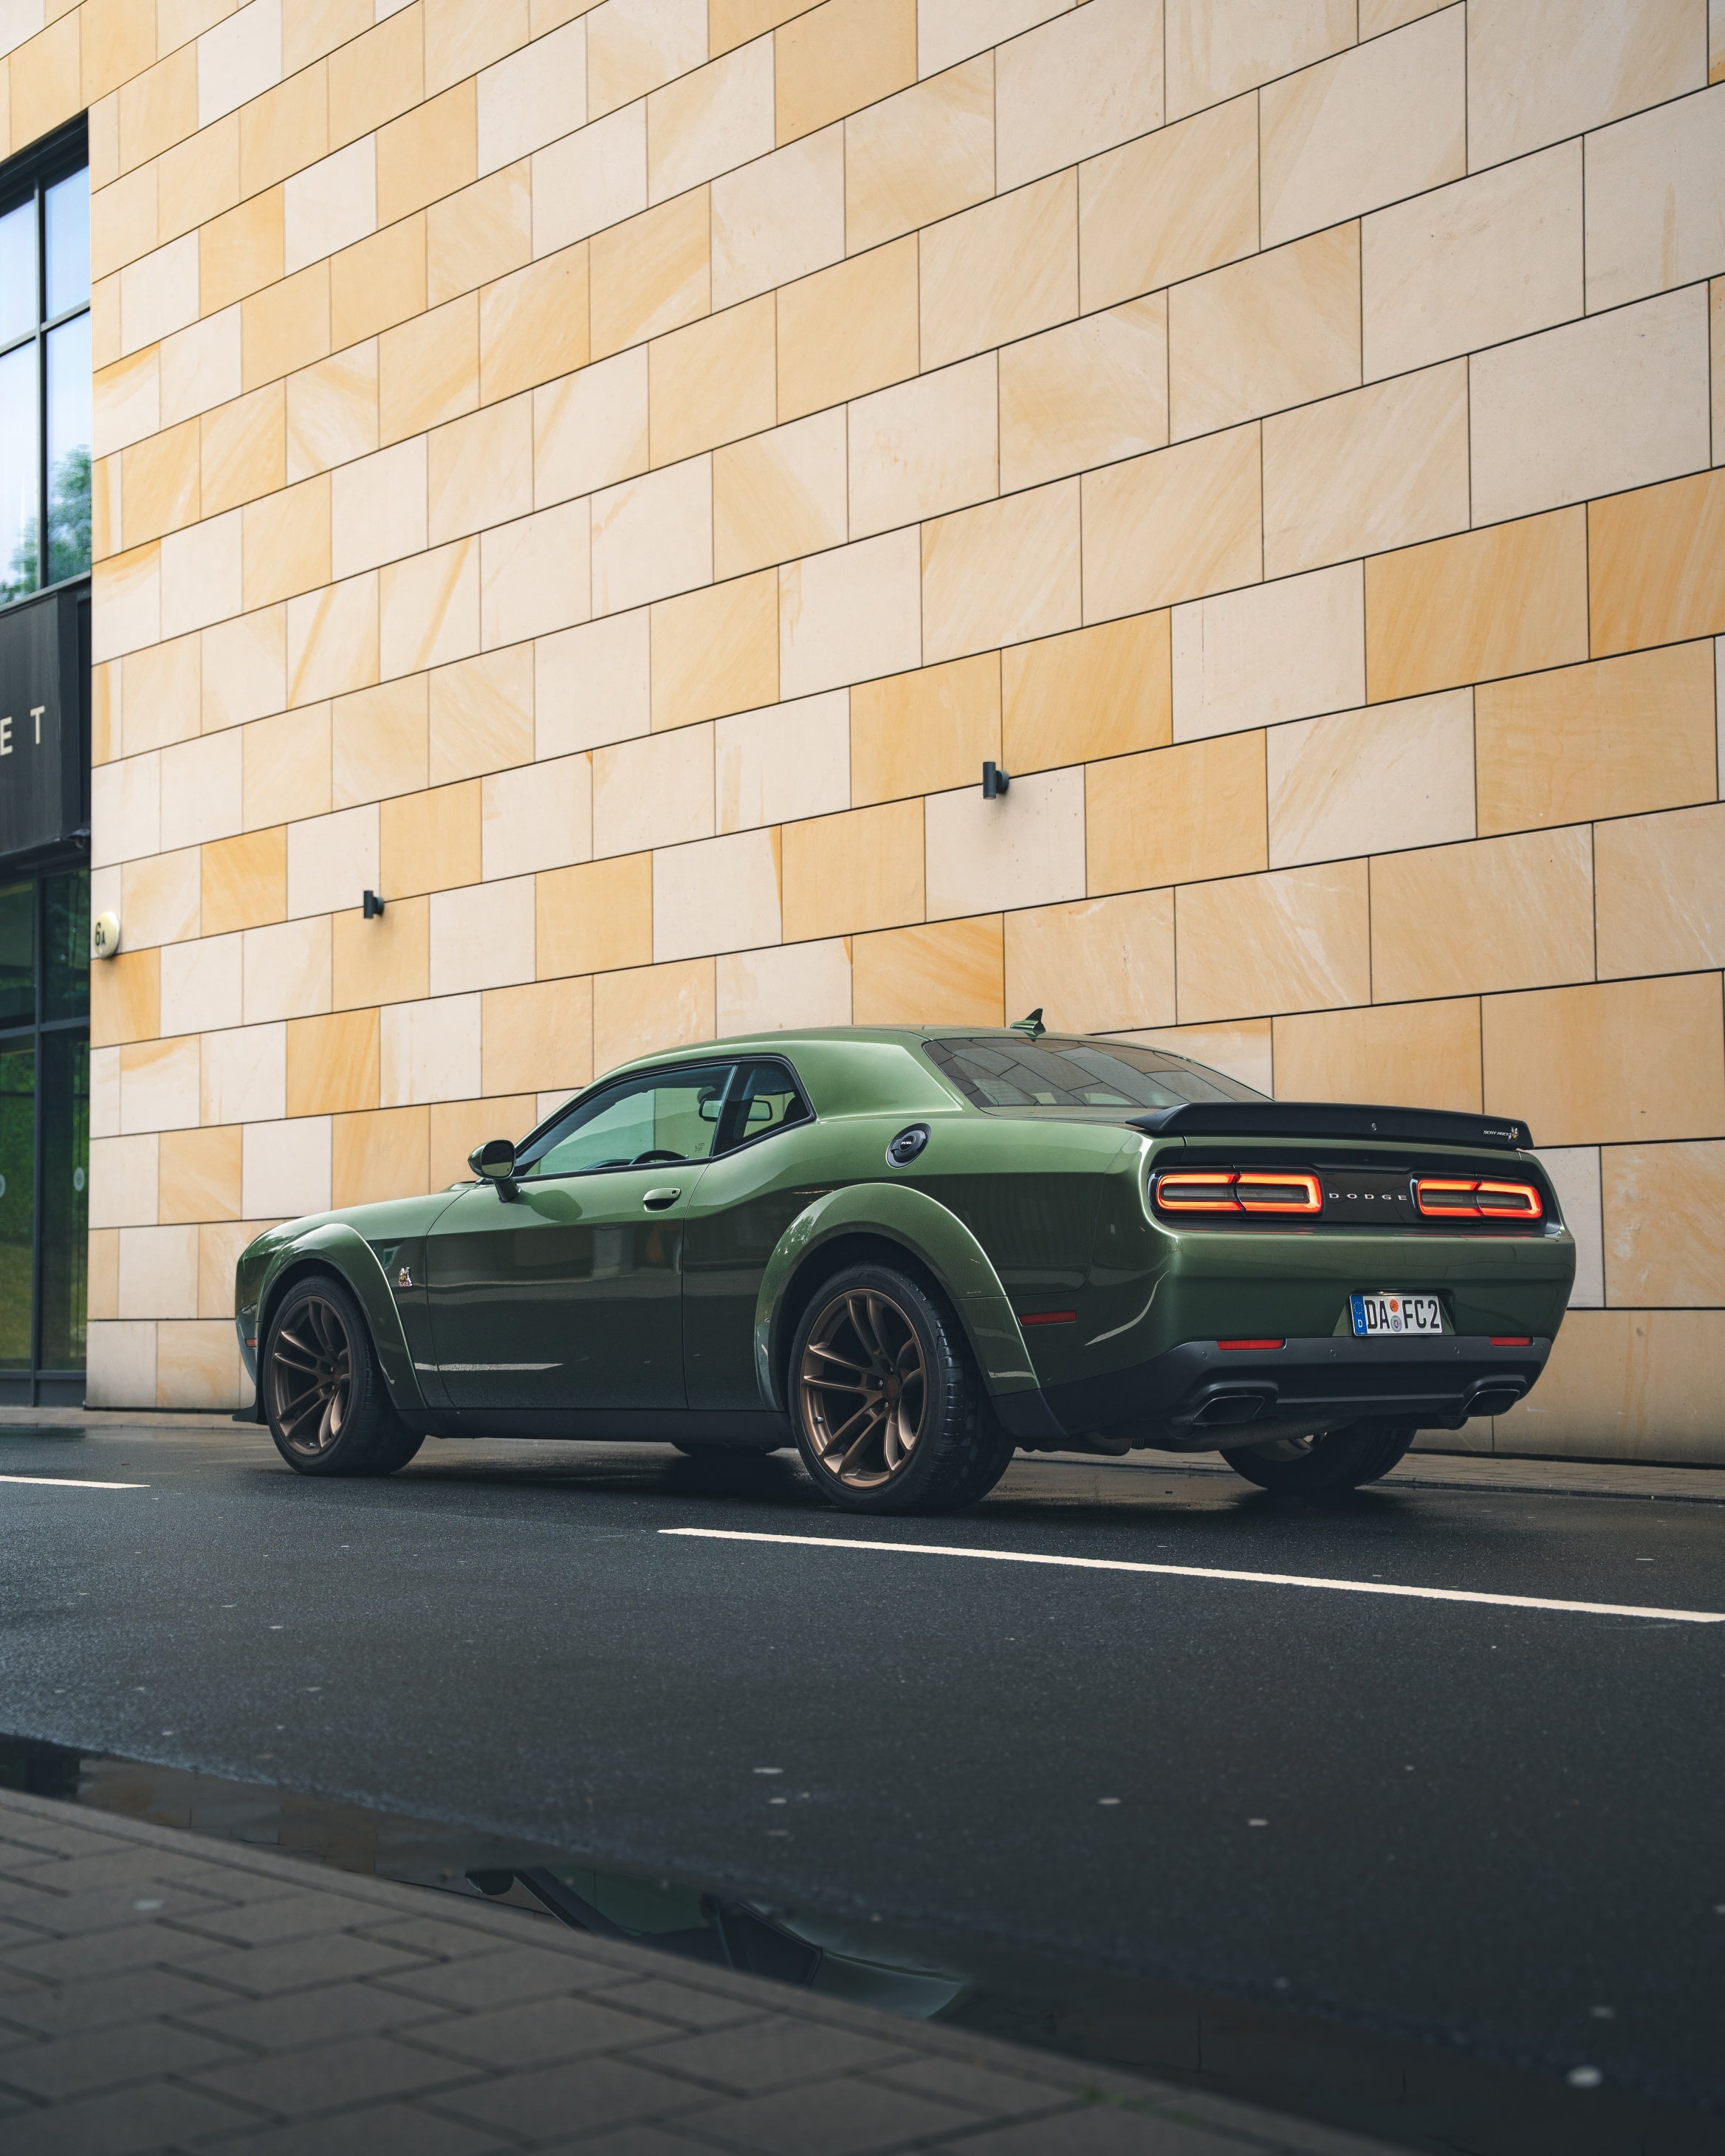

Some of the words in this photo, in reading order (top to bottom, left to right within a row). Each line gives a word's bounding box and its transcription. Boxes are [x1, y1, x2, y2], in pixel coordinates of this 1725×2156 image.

[95, 922, 106, 947] 6A
[1357, 1319, 1363, 1328] D
[1364, 1300, 1390, 1329] DA
[1402, 1300, 1440, 1329] FC2
